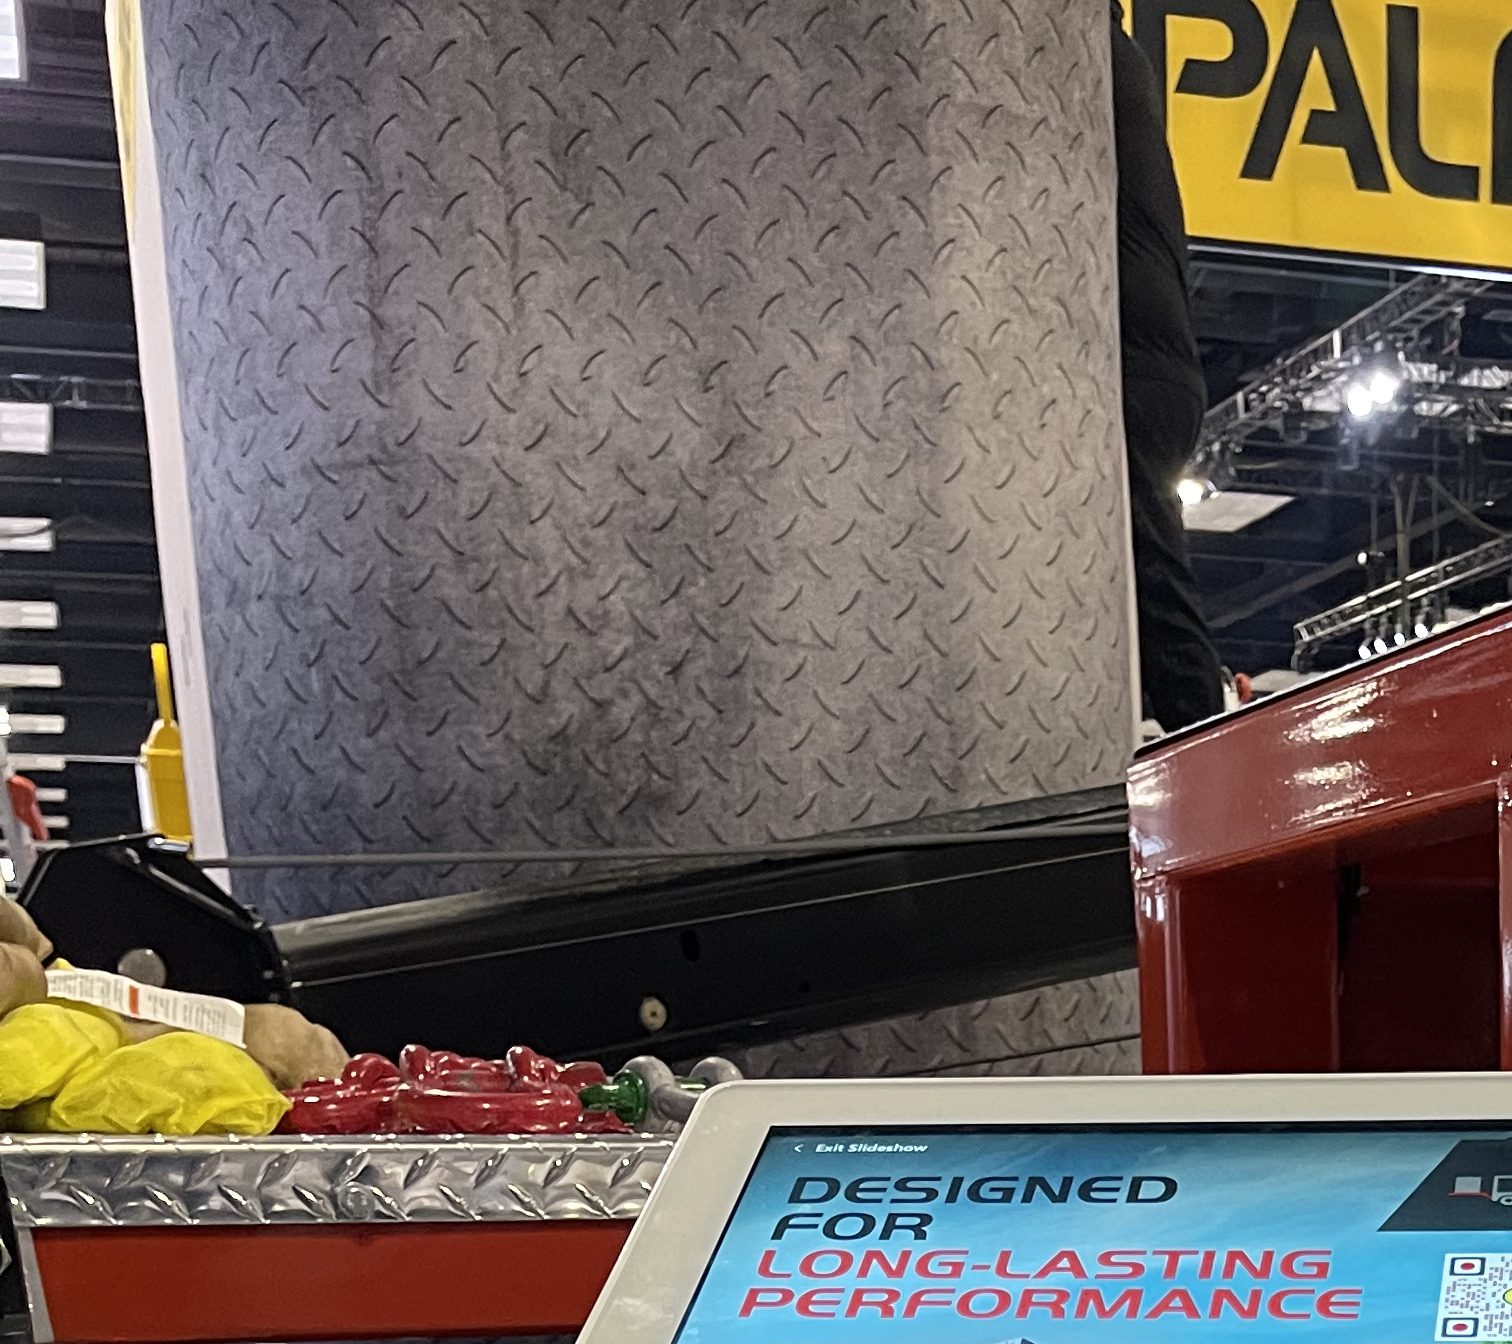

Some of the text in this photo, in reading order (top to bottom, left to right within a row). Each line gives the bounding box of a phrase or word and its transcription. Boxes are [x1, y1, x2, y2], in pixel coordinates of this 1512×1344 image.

[815, 1143, 928, 1154] Exit Slideshow
[787, 1176, 1179, 1204] DESIGNED
[770, 1212, 934, 1241] FOR
[756, 1249, 1332, 1280] LONG-LASTING
[738, 1287, 1363, 1320] PERFORMANCE
